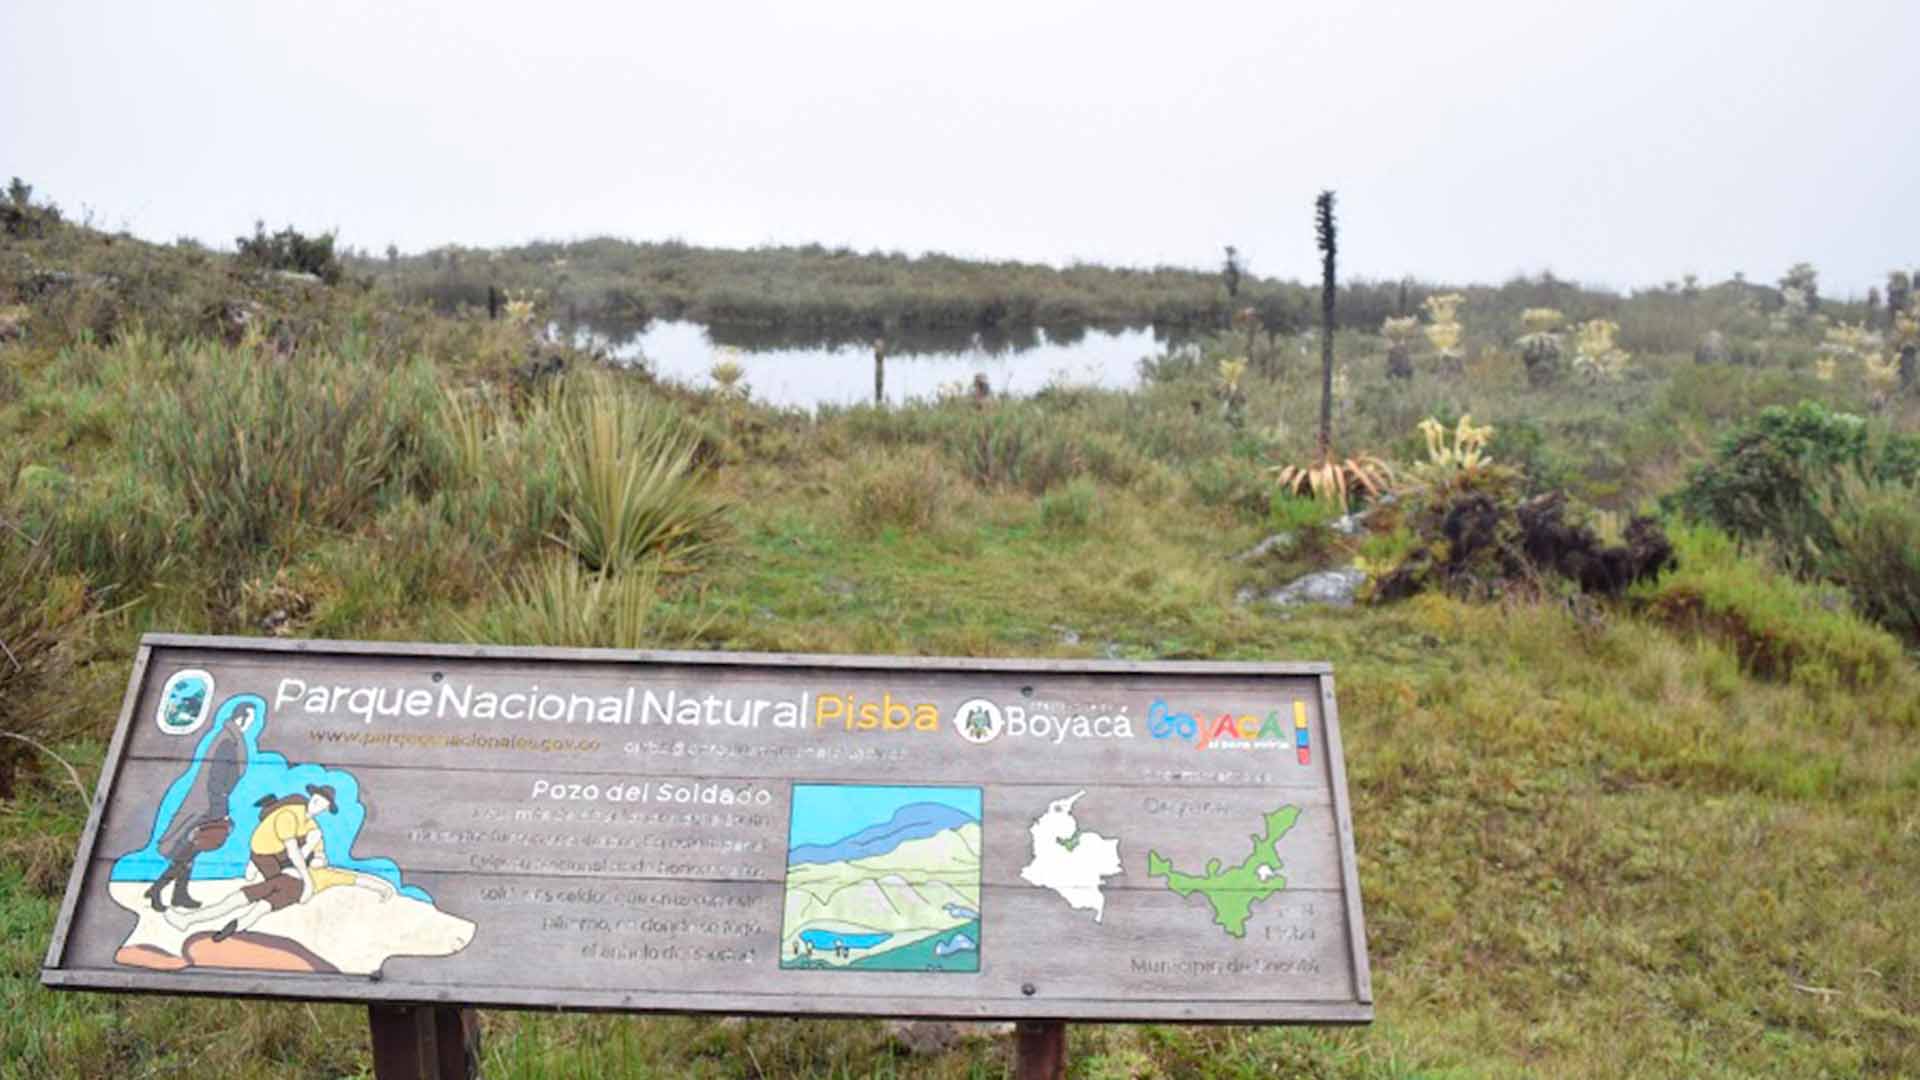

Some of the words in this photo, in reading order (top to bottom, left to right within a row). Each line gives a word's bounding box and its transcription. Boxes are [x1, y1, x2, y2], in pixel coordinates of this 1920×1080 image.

[274, 677, 432, 723] Parque
[437, 685, 636, 724] Nacional
[641, 689, 807, 728] Natural
[815, 693, 940, 731] Pisba
[1004, 704, 1134, 744] Boyacá
[532, 779, 600, 801] Pozo
[605, 782, 651, 803] del
[656, 784, 773, 806] Soldado
